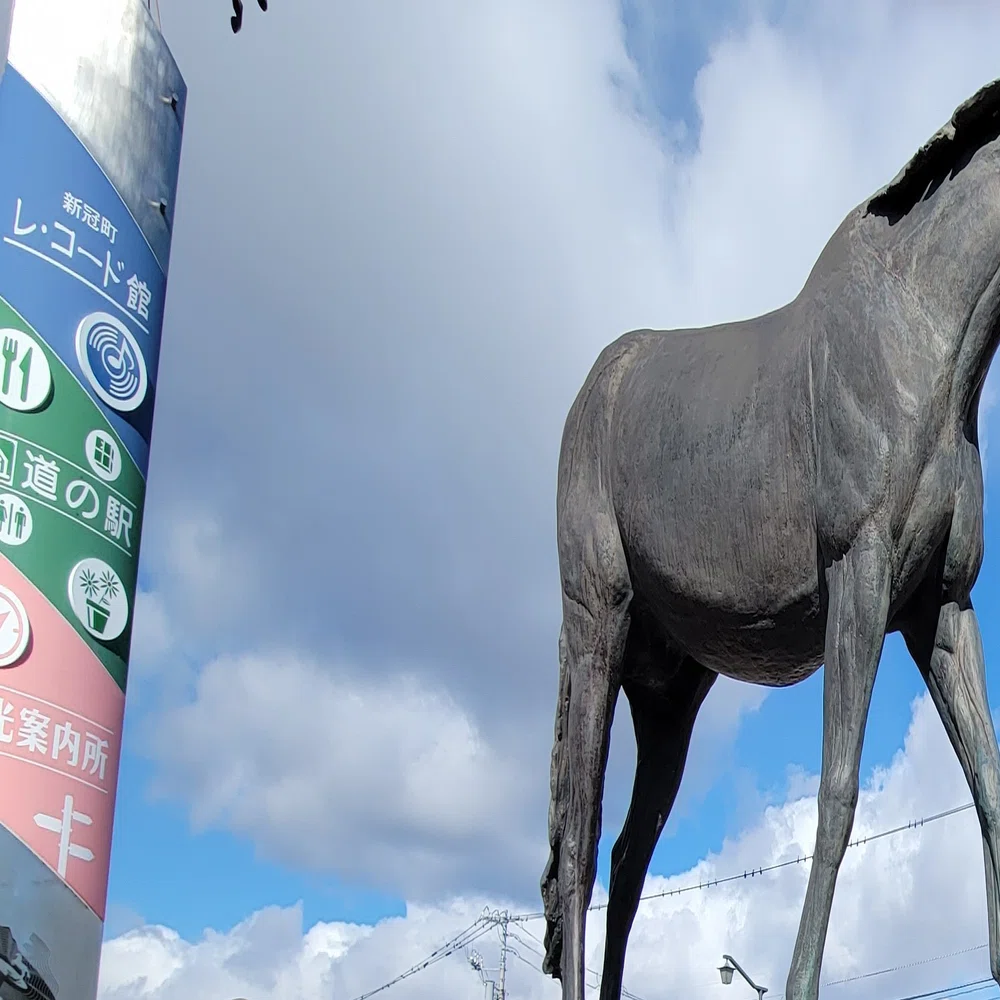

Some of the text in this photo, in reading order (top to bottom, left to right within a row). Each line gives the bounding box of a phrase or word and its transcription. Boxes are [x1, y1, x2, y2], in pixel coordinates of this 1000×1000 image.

[13, 197, 152, 321] レ・コード館
[62, 191, 118, 244] 新冠町
[21, 449, 133, 549] 道の駅
